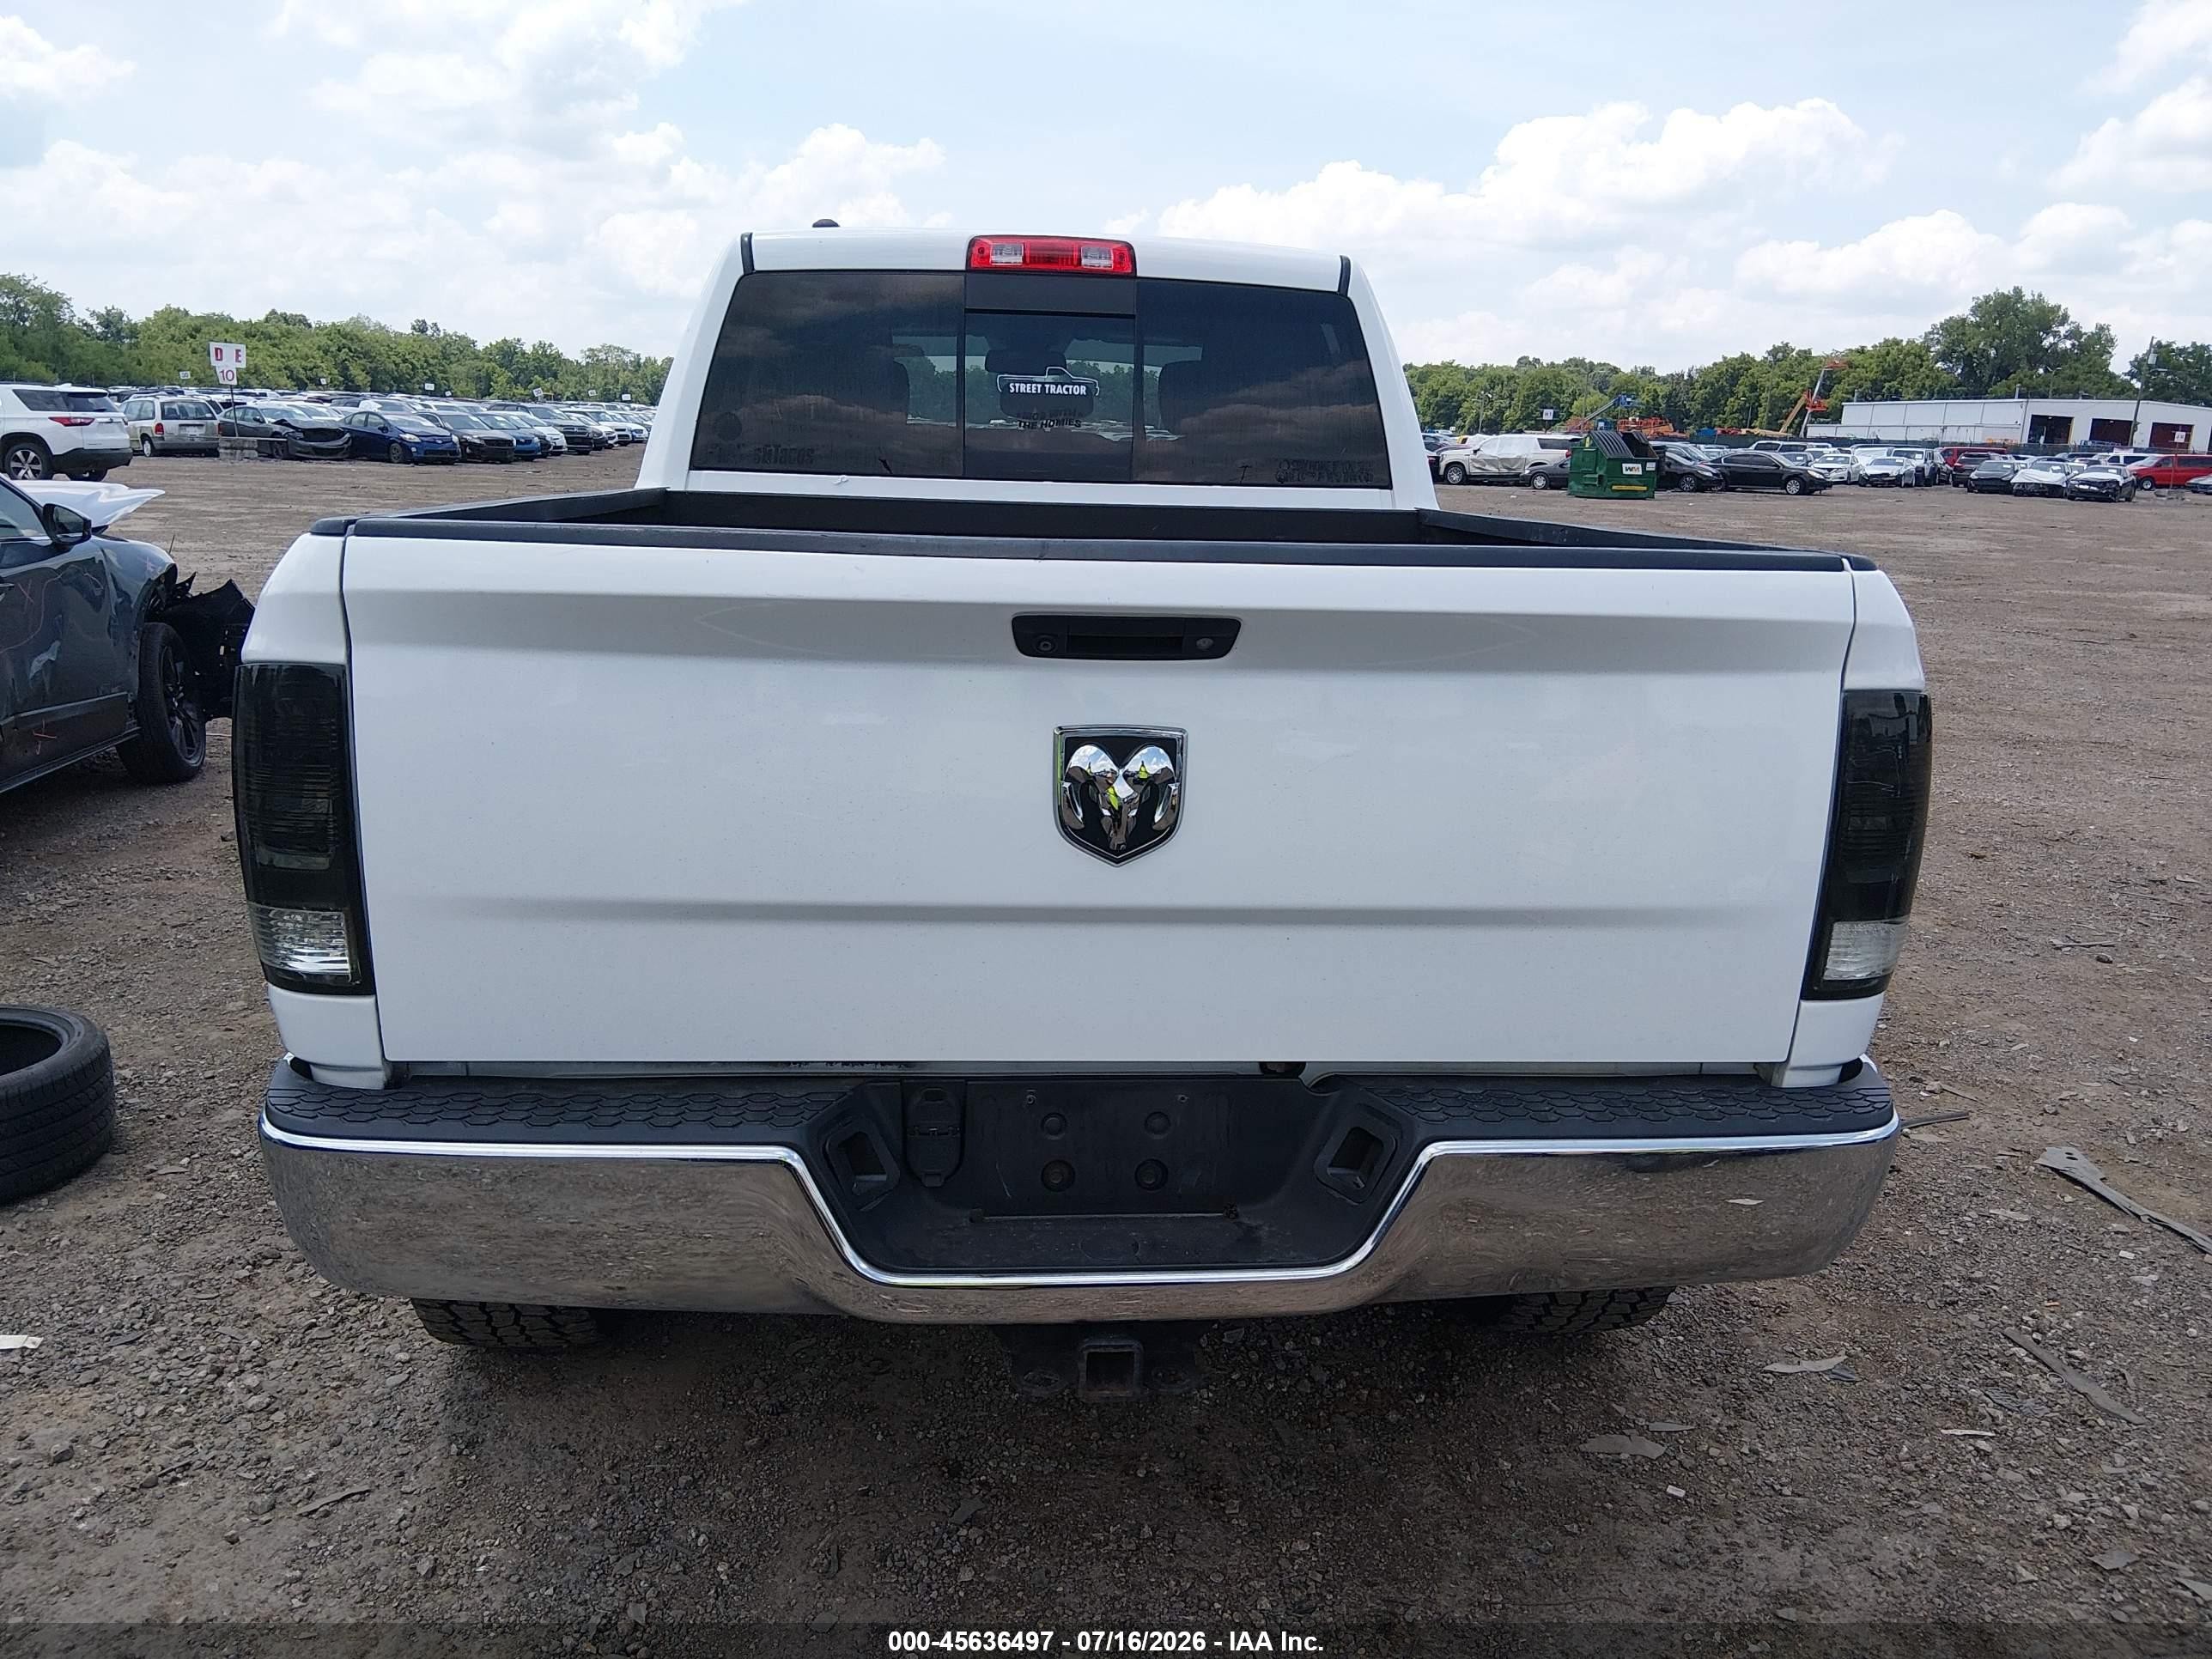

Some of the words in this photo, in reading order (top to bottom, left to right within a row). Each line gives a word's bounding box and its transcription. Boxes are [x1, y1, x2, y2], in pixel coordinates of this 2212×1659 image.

[214, 347, 223, 362] D
[234, 349, 242, 363] E
[219, 369, 234, 381] 10
[1009, 382, 1042, 394] STREET
[1044, 383, 1087, 396] TRACTOR
[1018, 419, 1037, 429] THE
[1040, 417, 1082, 428] HOMIES
